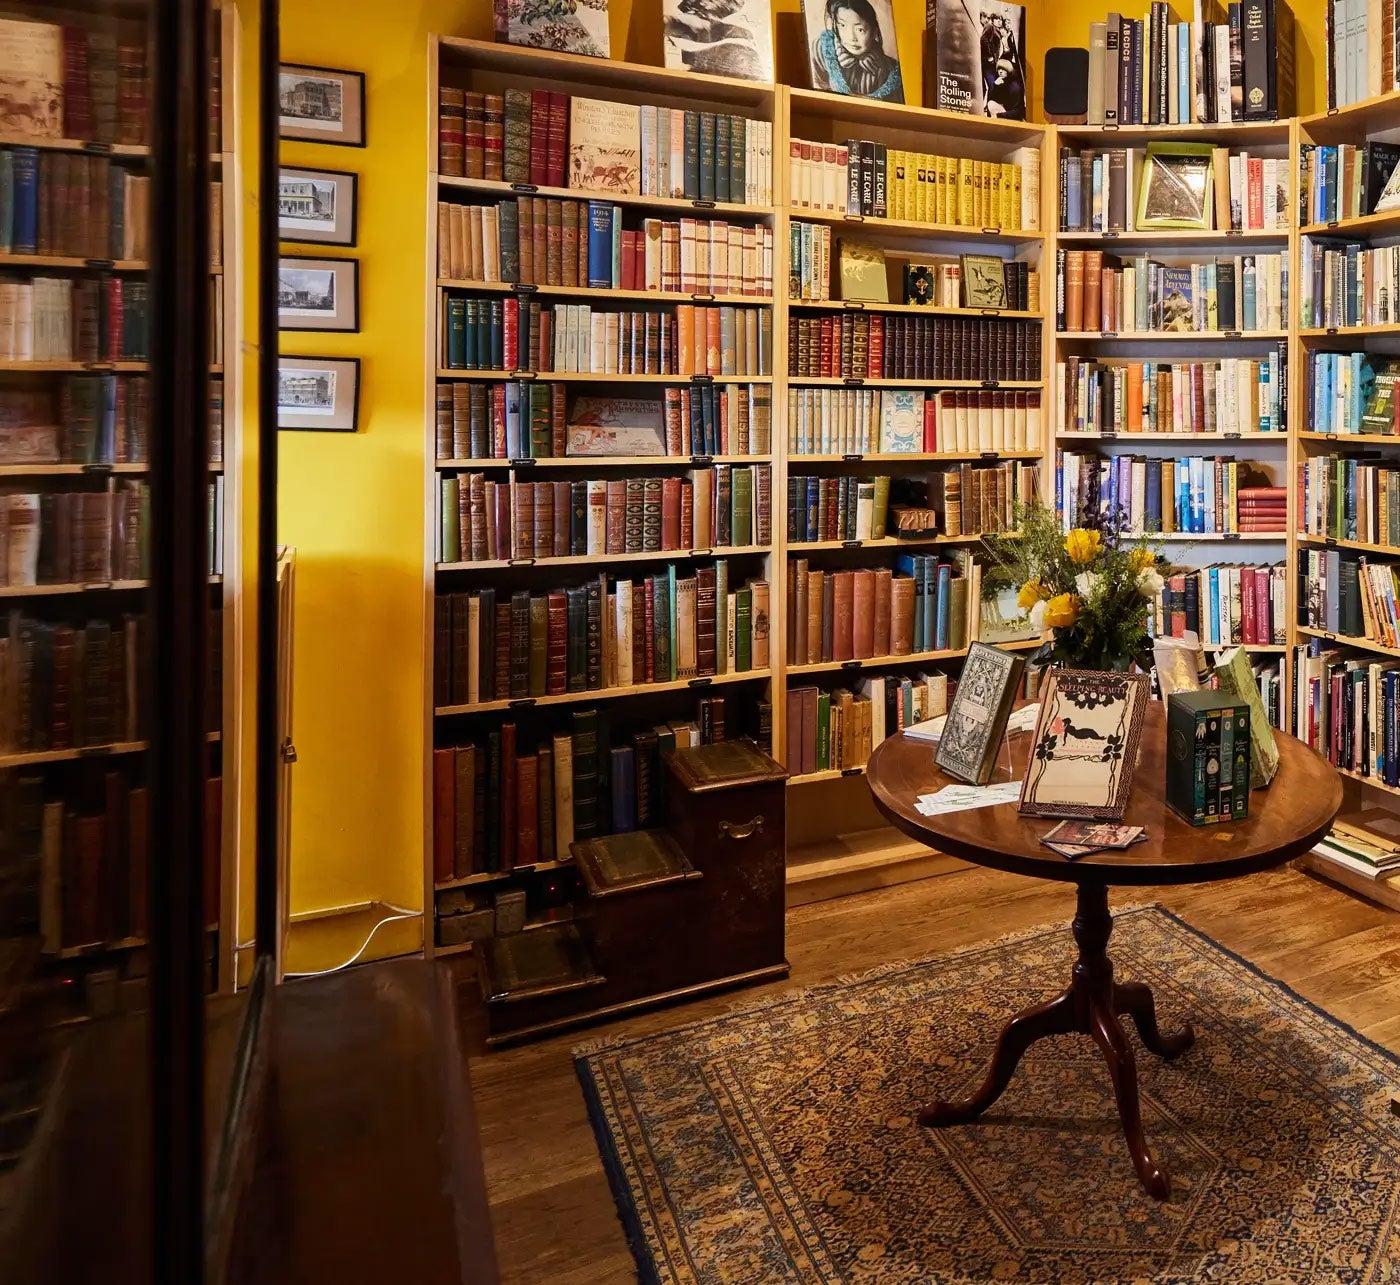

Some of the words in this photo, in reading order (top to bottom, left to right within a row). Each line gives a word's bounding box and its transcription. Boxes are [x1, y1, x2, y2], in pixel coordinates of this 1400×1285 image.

[939, 75, 958, 86] The
[939, 84, 972, 100] Rolling
[940, 94, 972, 107] Stones
[592, 208, 609, 216] 1914
[1058, 684, 1097, 692] SLEEPING
[1098, 686, 1127, 694] BEAUTY
